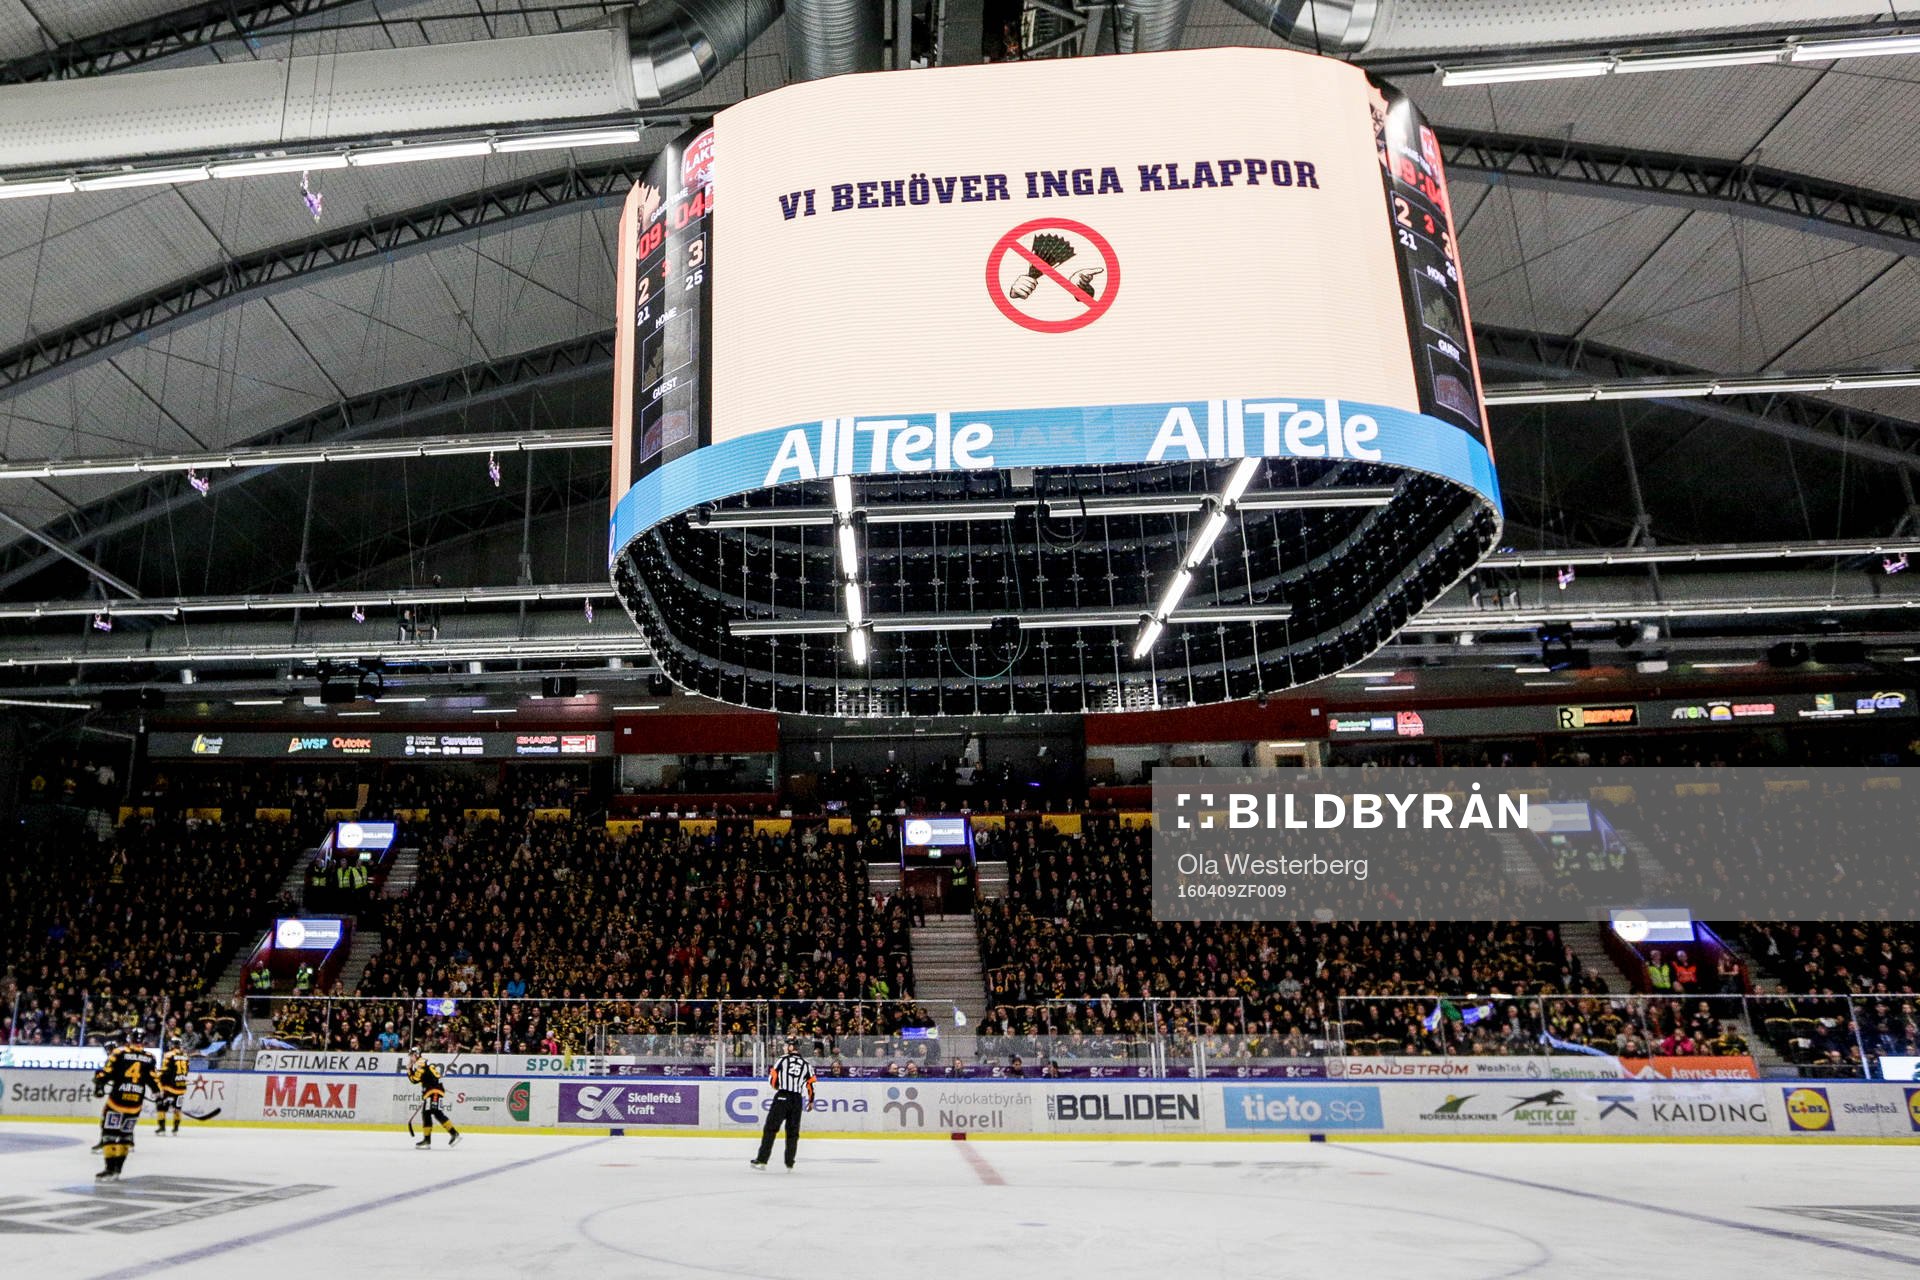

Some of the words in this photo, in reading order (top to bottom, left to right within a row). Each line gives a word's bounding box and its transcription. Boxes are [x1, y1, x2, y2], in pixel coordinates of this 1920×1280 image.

[779, 188, 816, 221] VI
[832, 172, 1011, 212] BEHÖVER
[1025, 167, 1124, 199] INGA
[1138, 158, 1320, 190] KLAPPOR
[1394, 197, 1412, 228] 2
[1398, 229, 1418, 251] 21
[688, 239, 704, 268] 3
[684, 269, 704, 291] 25
[638, 276, 650, 306] 2
[637, 306, 650, 327] 21
[655, 306, 678, 329] HOME
[652, 376, 678, 400] GUEST
[1145, 399, 1382, 462] AllTele
[763, 411, 995, 486] AllTele
[301, 738, 328, 749] WSP
[124, 1061, 141, 1083] 4
[279, 1054, 349, 1071] STILMEK
[355, 1056, 379, 1071] AB
[788, 1062, 802, 1076] 25
[1349, 1062, 1469, 1077] SANDSTRÖM
[11, 1082, 93, 1103] Statkraft
[264, 1075, 358, 1109] MAXI
[628, 1091, 682, 1105] Skellefteå
[938, 1091, 1033, 1106] Advokatbyrån
[280, 1108, 356, 1119] STORMARKNAD
[627, 1106, 655, 1116] Kraft
[1056, 1093, 1199, 1121] BOLIDEN
[1240, 1094, 1366, 1122] tieto.se
[1419, 1112, 1499, 1121] NORRMASKINER
[1514, 1109, 1552, 1122] ARCTIC
[1556, 1109, 1578, 1122] CAT
[1652, 1103, 1768, 1122] KAIDING
[939, 1110, 1004, 1129] Norell
